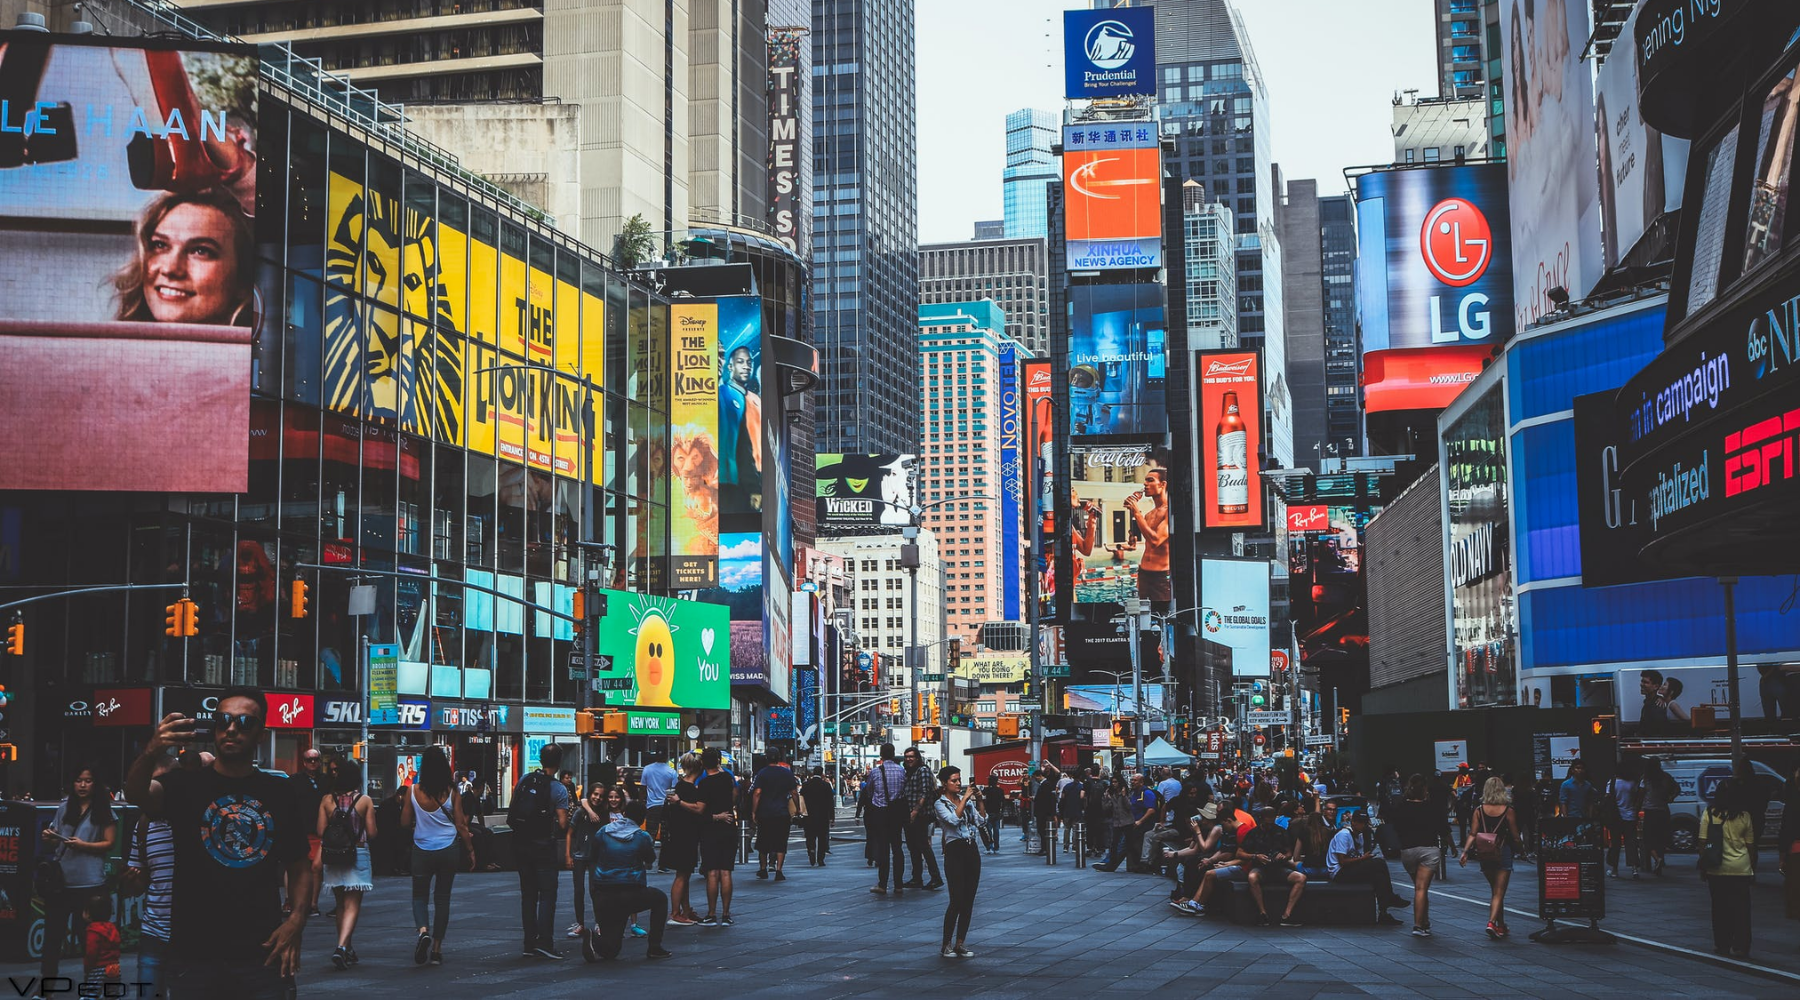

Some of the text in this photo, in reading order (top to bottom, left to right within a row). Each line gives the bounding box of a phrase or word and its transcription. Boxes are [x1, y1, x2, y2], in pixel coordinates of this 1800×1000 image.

[1084, 69, 1136, 81] Prudential
[85, 103, 228, 143] HAAN
[772, 66, 795, 195] TIMES
[1072, 129, 1149, 144] 新华通讯社
[1086, 244, 1142, 257] XINHUA
[1074, 255, 1155, 267] NEWS AGENCY
[515, 296, 551, 347] THE
[678, 316, 708, 328] Disney
[1429, 292, 1491, 345] LG
[681, 336, 705, 348] THE
[1747, 333, 1767, 362] abc
[677, 351, 711, 371] LION
[1076, 351, 1154, 364] Live beautiful
[1210, 363, 1248, 372] Budweiser
[675, 372, 717, 396] KING
[1643, 391, 1655, 436] in
[1655, 351, 1730, 426] campaign
[825, 498, 873, 513] WICKED
[1450, 521, 1493, 589] OLD NAVY
[1224, 615, 1267, 625] THE GLOBAL GOALS
[1051, 667, 1062, 675] 44
[603, 680, 611, 689] W
[613, 680, 623, 689] 44
[630, 716, 679, 730] NEW YORK LINE
[1210, 732, 1220, 751] tkts
